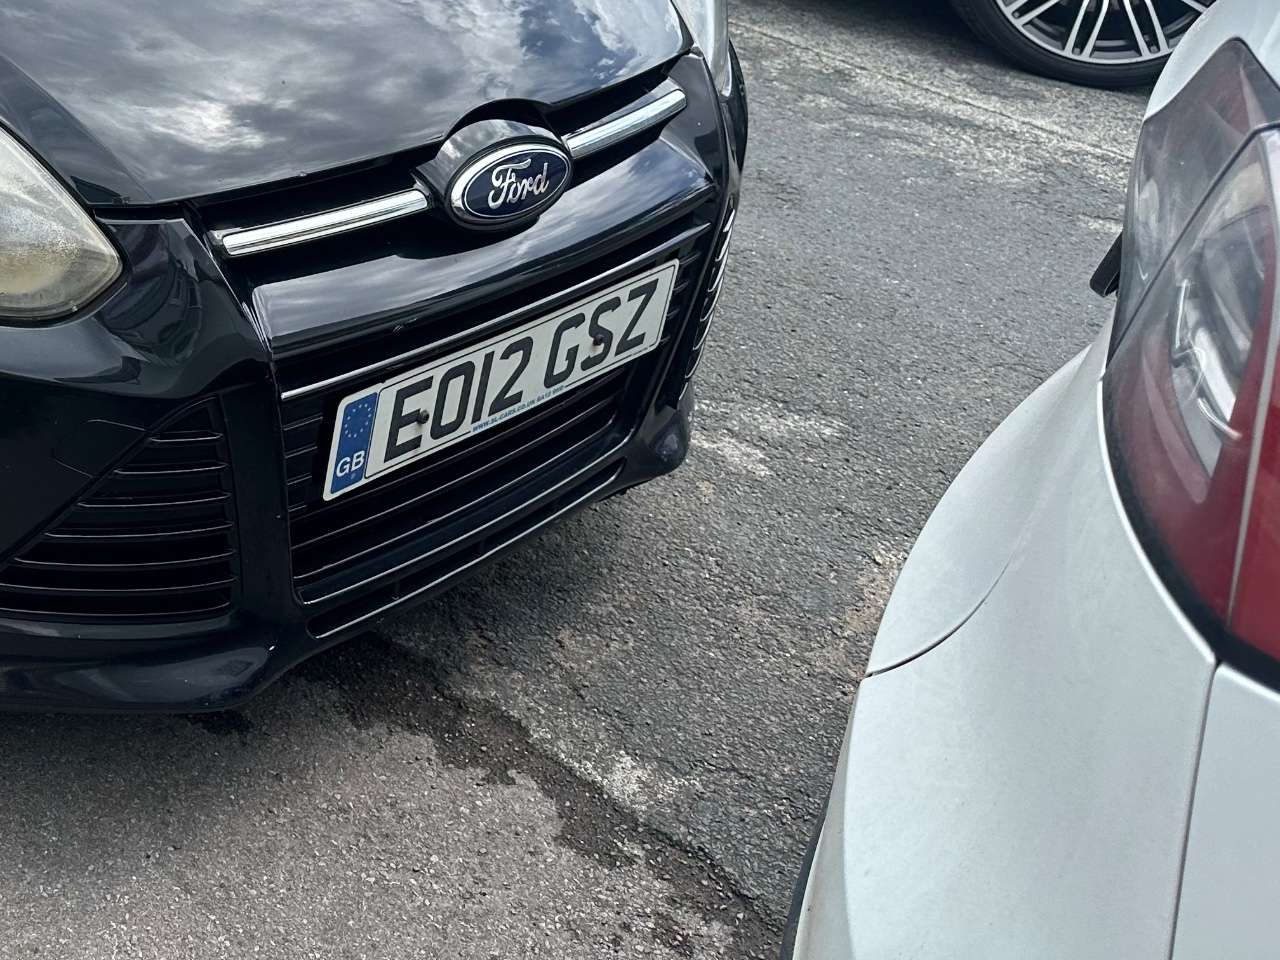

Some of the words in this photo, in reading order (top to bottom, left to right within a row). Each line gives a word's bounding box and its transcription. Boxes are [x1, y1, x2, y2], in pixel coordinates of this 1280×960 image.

[487, 158, 550, 209] Ford
[543, 278, 659, 389] GSZ
[335, 449, 365, 478] GB
